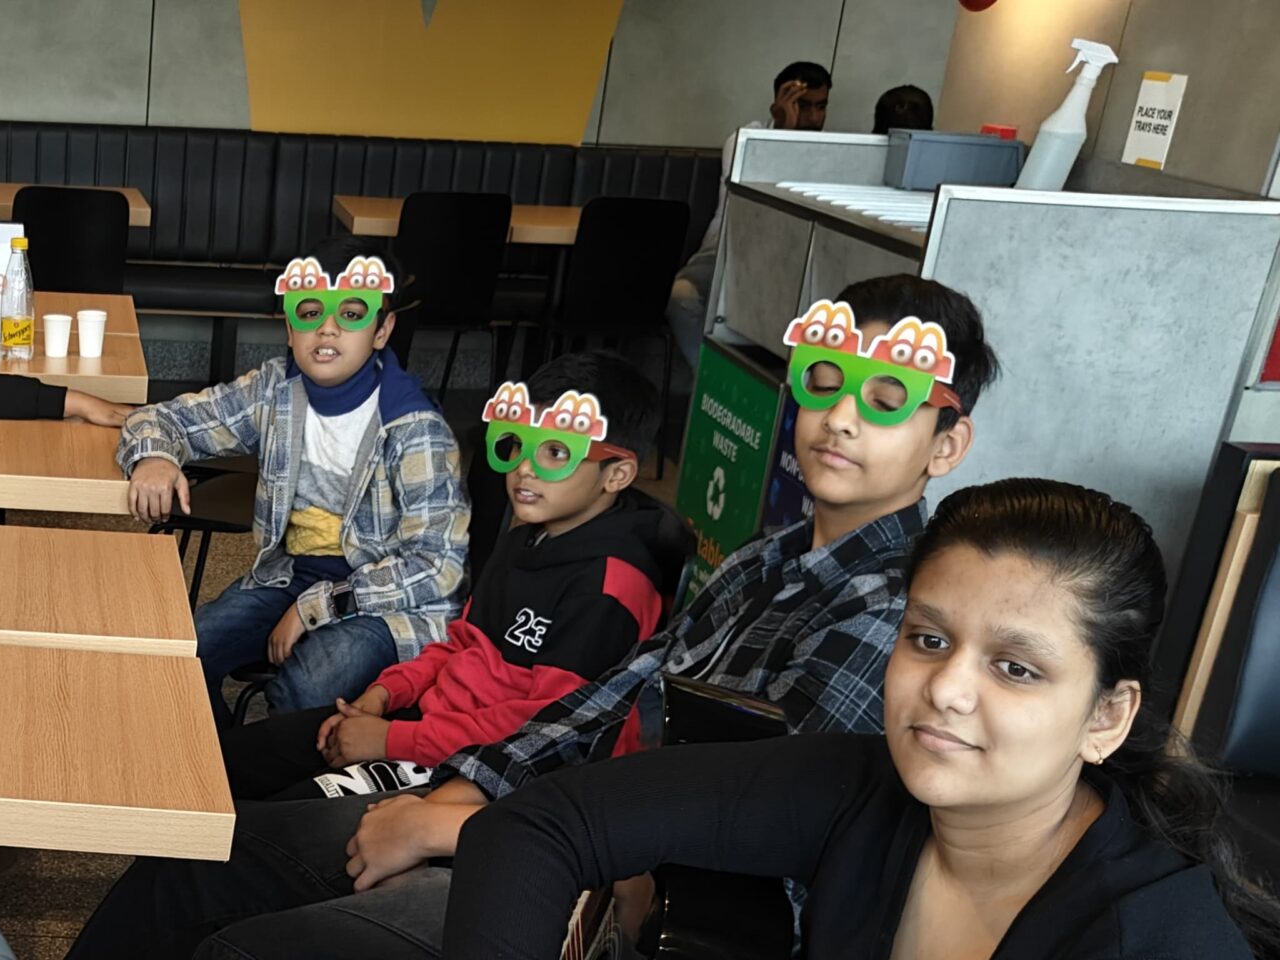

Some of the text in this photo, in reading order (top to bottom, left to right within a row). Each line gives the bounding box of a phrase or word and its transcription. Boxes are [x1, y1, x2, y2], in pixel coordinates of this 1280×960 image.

[1137, 105, 1173, 121] PLACE YOUR
[1134, 121, 1169, 136] TRAYS HERE
[701, 393, 761, 450] BIODEGRADABLE
[713, 430, 738, 463] WASTE
